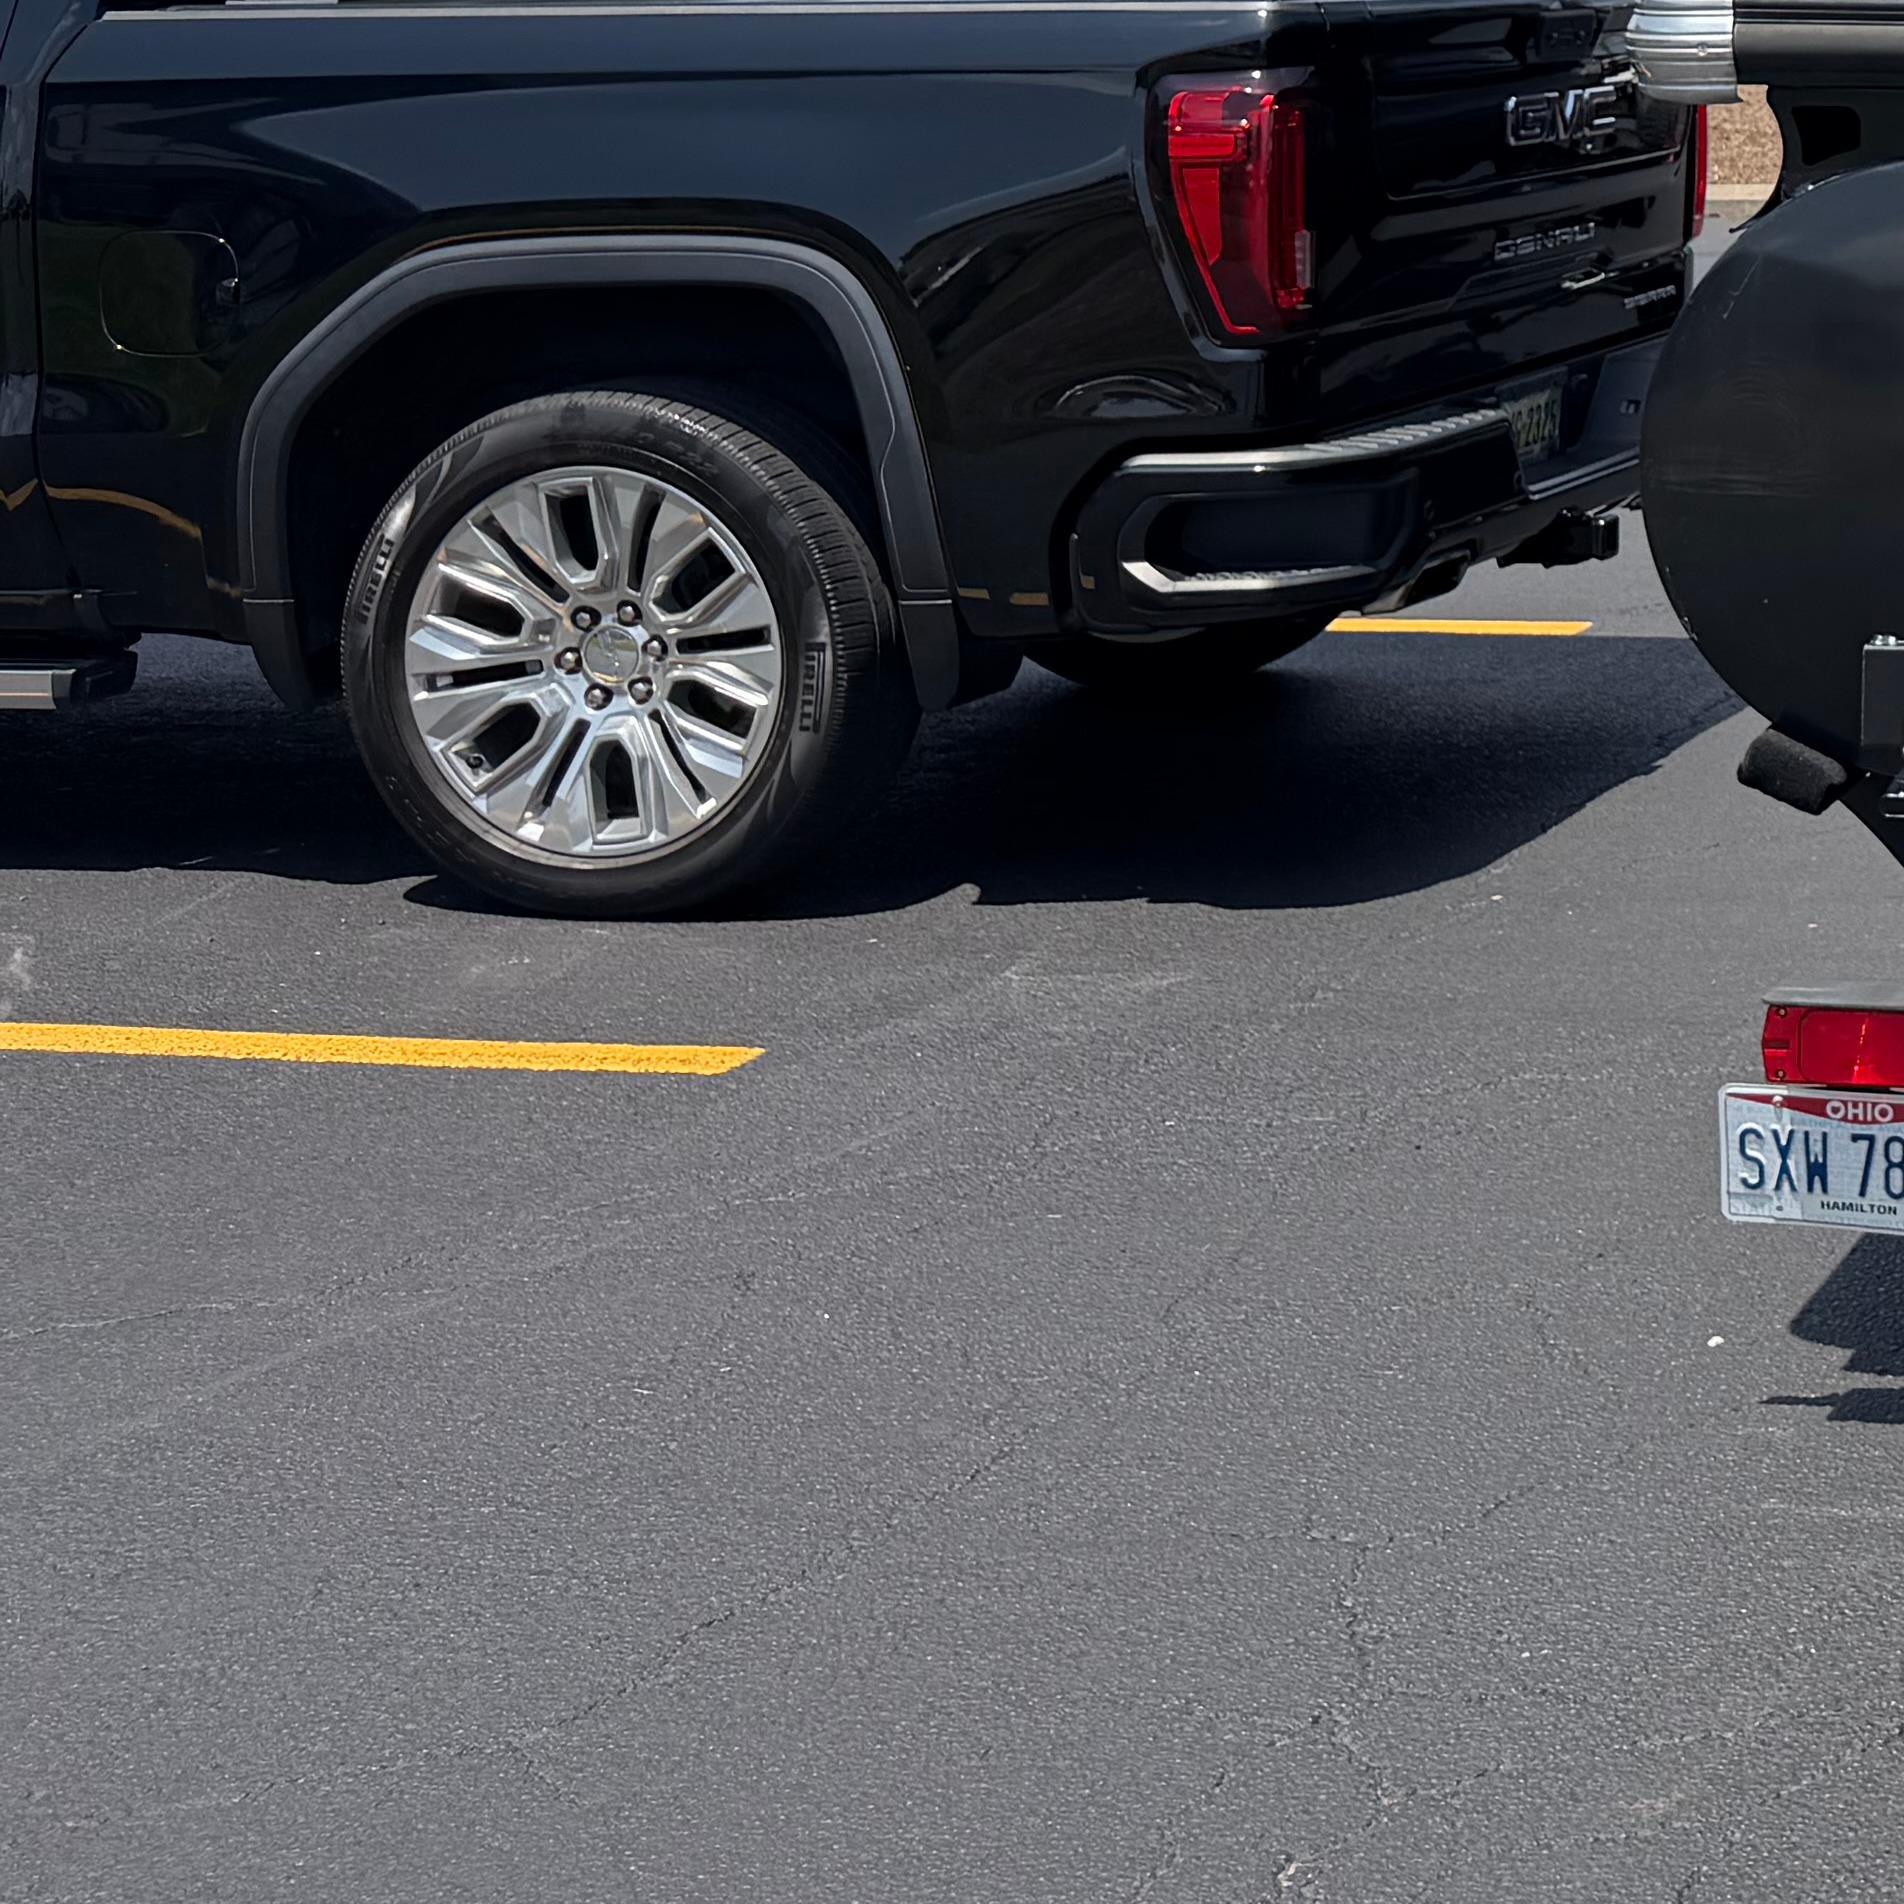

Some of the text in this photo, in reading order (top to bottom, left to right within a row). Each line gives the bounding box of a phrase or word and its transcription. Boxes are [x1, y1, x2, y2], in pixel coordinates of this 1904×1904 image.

[1504, 85, 1618, 146] GMC
[1494, 221, 1596, 262] DENALI
[1825, 1099, 1895, 1123] OHIO
[1738, 1127, 1829, 1194] SXW
[1819, 1200, 1898, 1216] HAMILTON
